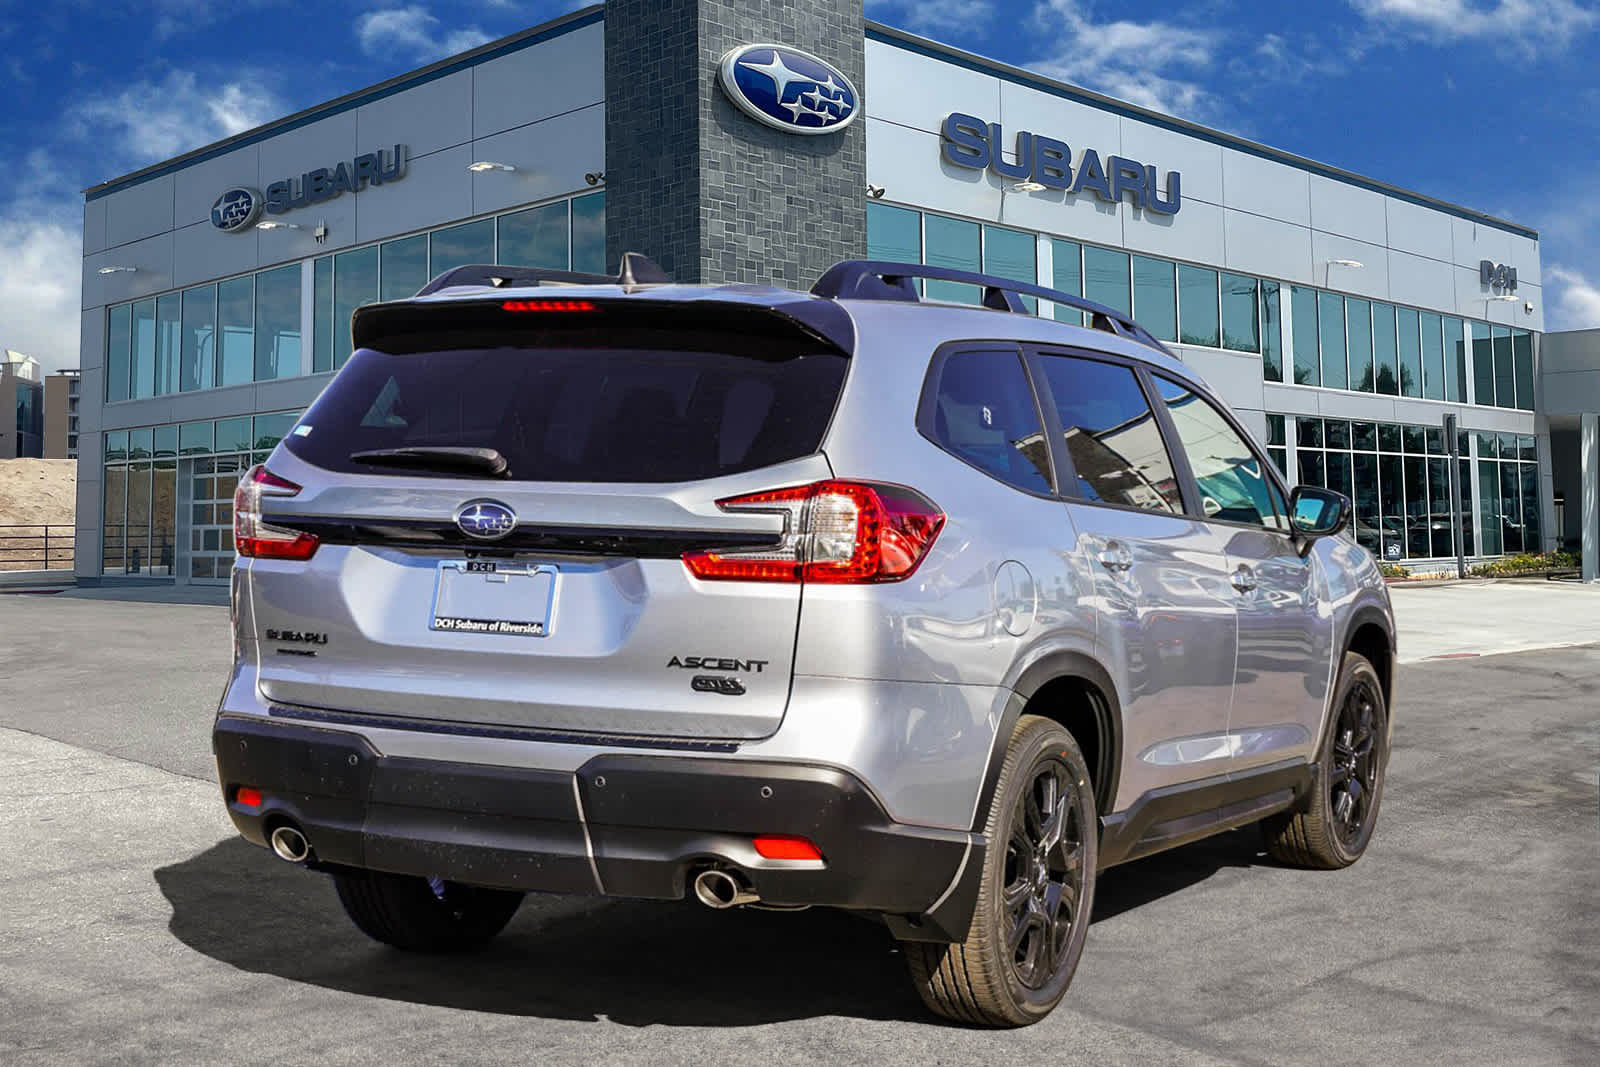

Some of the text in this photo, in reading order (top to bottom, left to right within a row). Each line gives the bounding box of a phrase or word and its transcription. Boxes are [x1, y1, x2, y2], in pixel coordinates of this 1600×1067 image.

[942, 112, 1181, 215] SUBARU
[266, 143, 407, 215] SUBARU
[472, 562, 493, 571] DCH
[434, 618, 543, 634] DCH Subaru of Riverside
[666, 655, 769, 672] ASCENT
